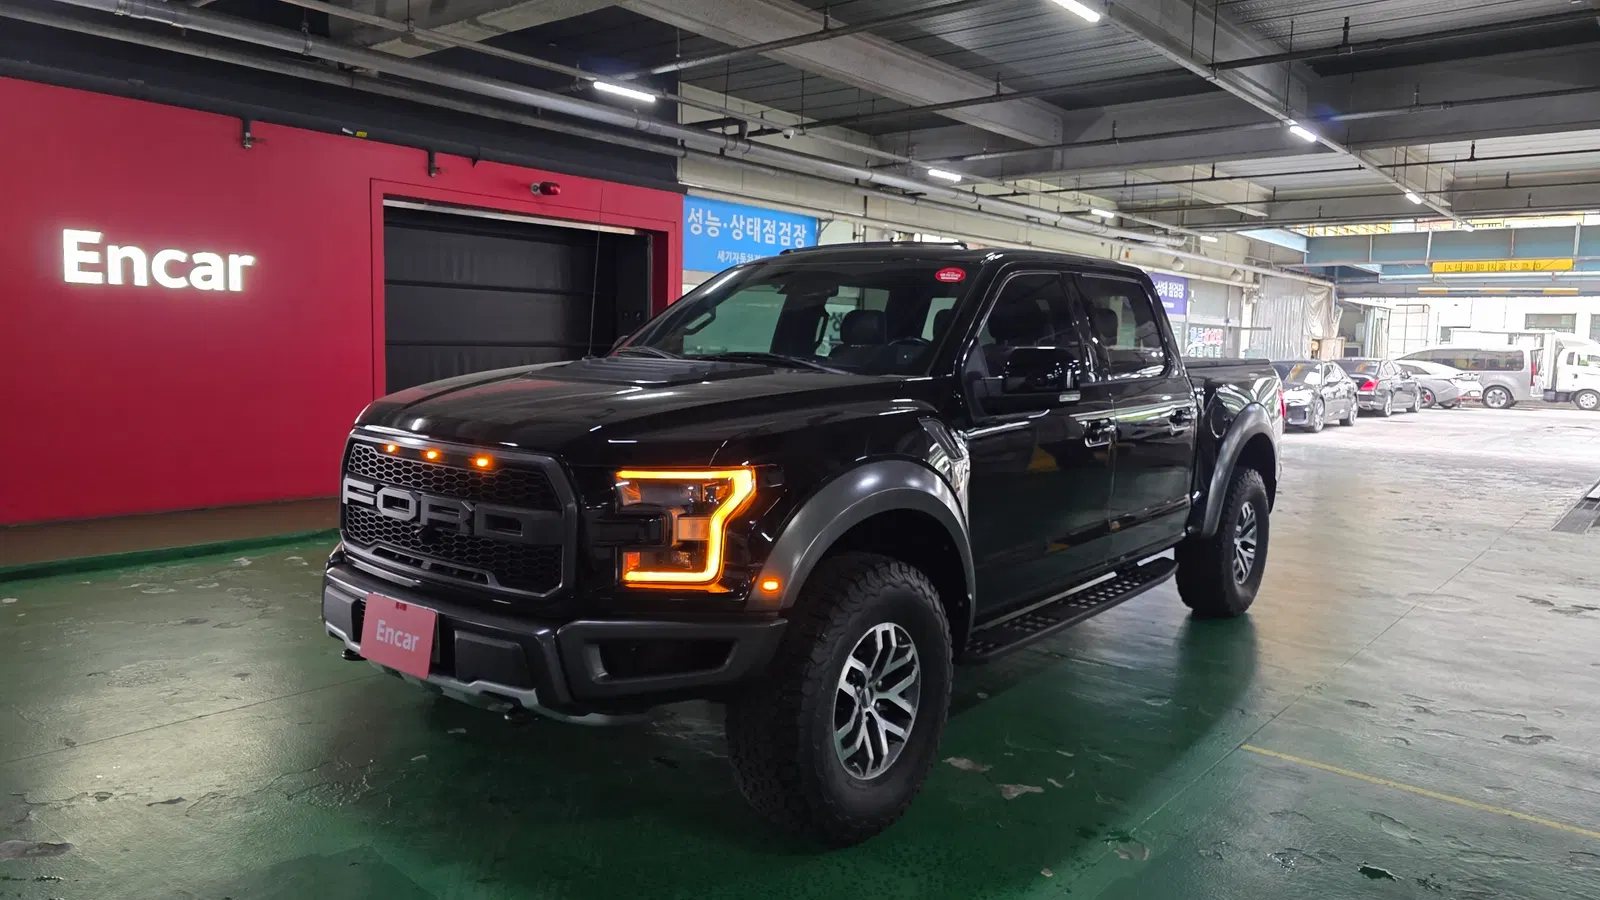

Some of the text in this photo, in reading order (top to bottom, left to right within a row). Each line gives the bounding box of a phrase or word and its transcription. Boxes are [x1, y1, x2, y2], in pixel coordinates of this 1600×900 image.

[687, 207, 807, 248] 성능·상태점검장
[62, 228, 256, 292] Encar
[342, 476, 530, 538] FORD
[376, 619, 420, 652] Encar
